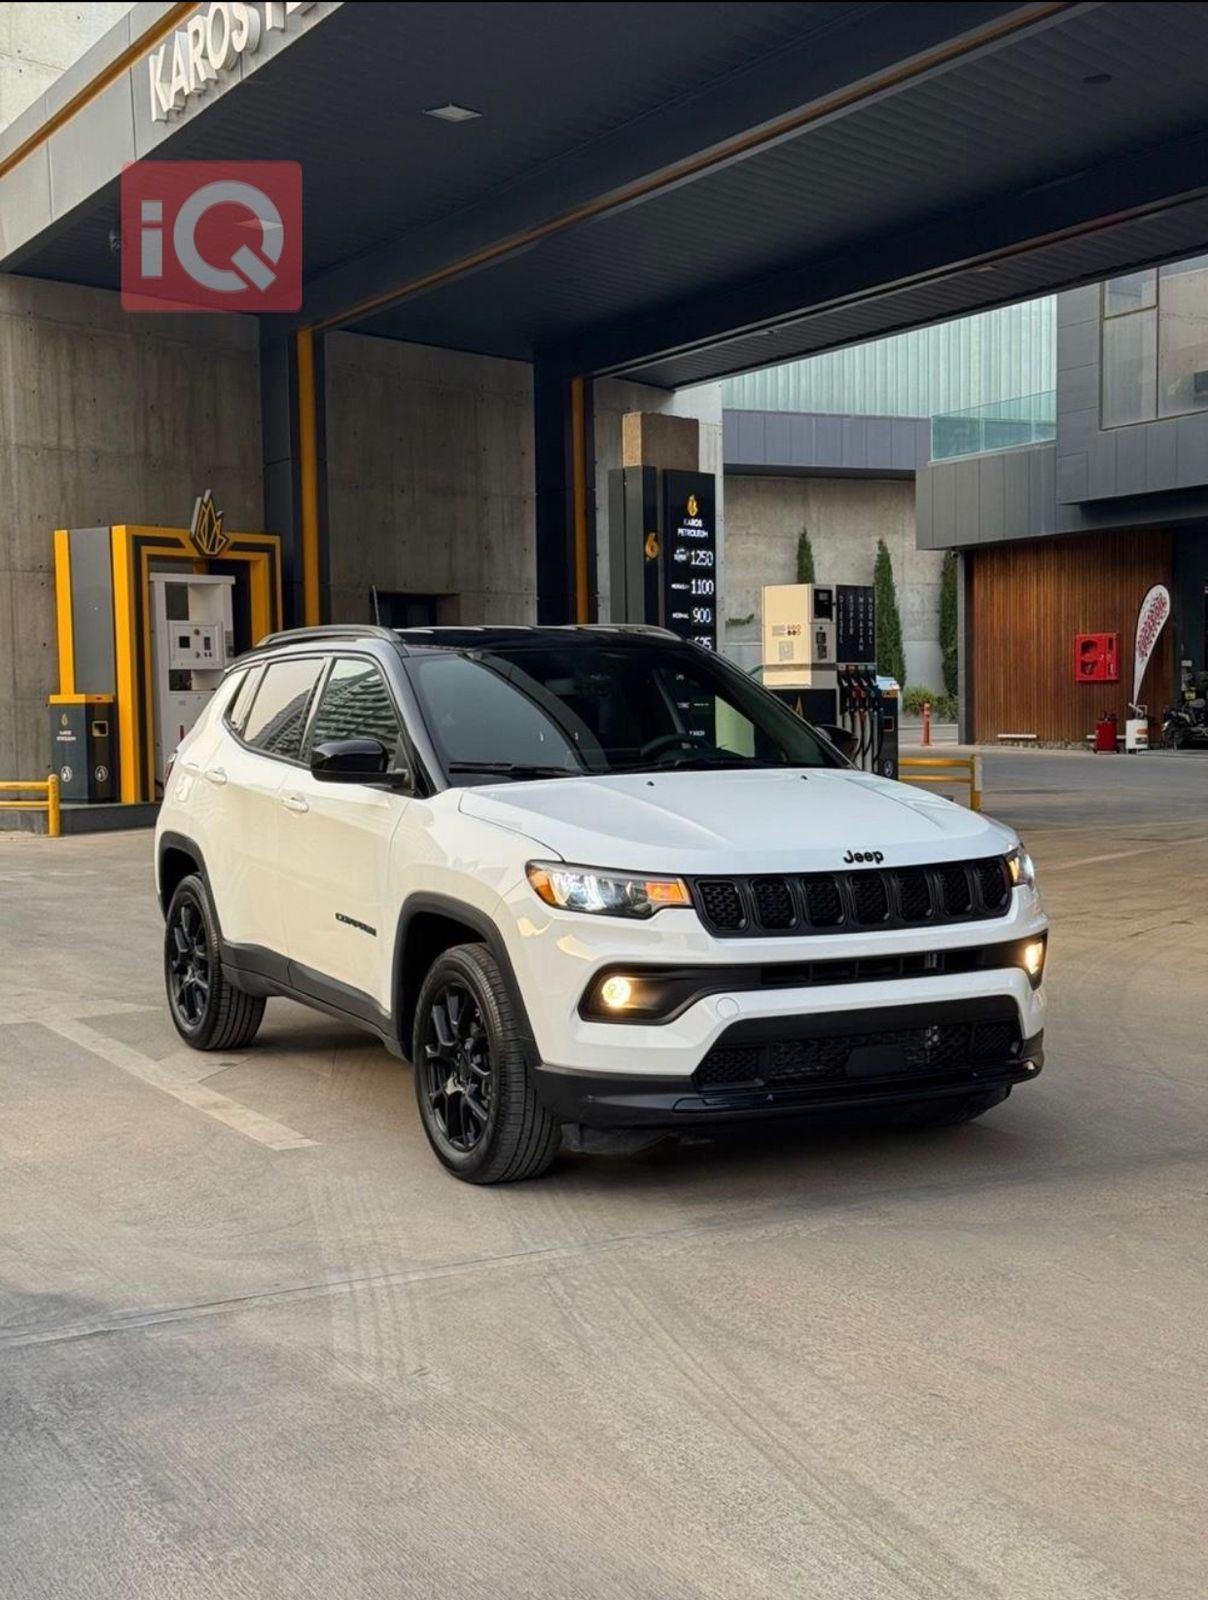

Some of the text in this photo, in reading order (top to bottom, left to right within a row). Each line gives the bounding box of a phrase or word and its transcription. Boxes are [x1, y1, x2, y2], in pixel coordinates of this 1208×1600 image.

[149, 2, 260, 122] KAROS
[691, 550, 714, 567] 1250
[691, 578, 714, 594] 1100
[693, 607, 712, 623] 900
[694, 636, 712, 652] 25
[843, 850, 884, 864] Jeep
